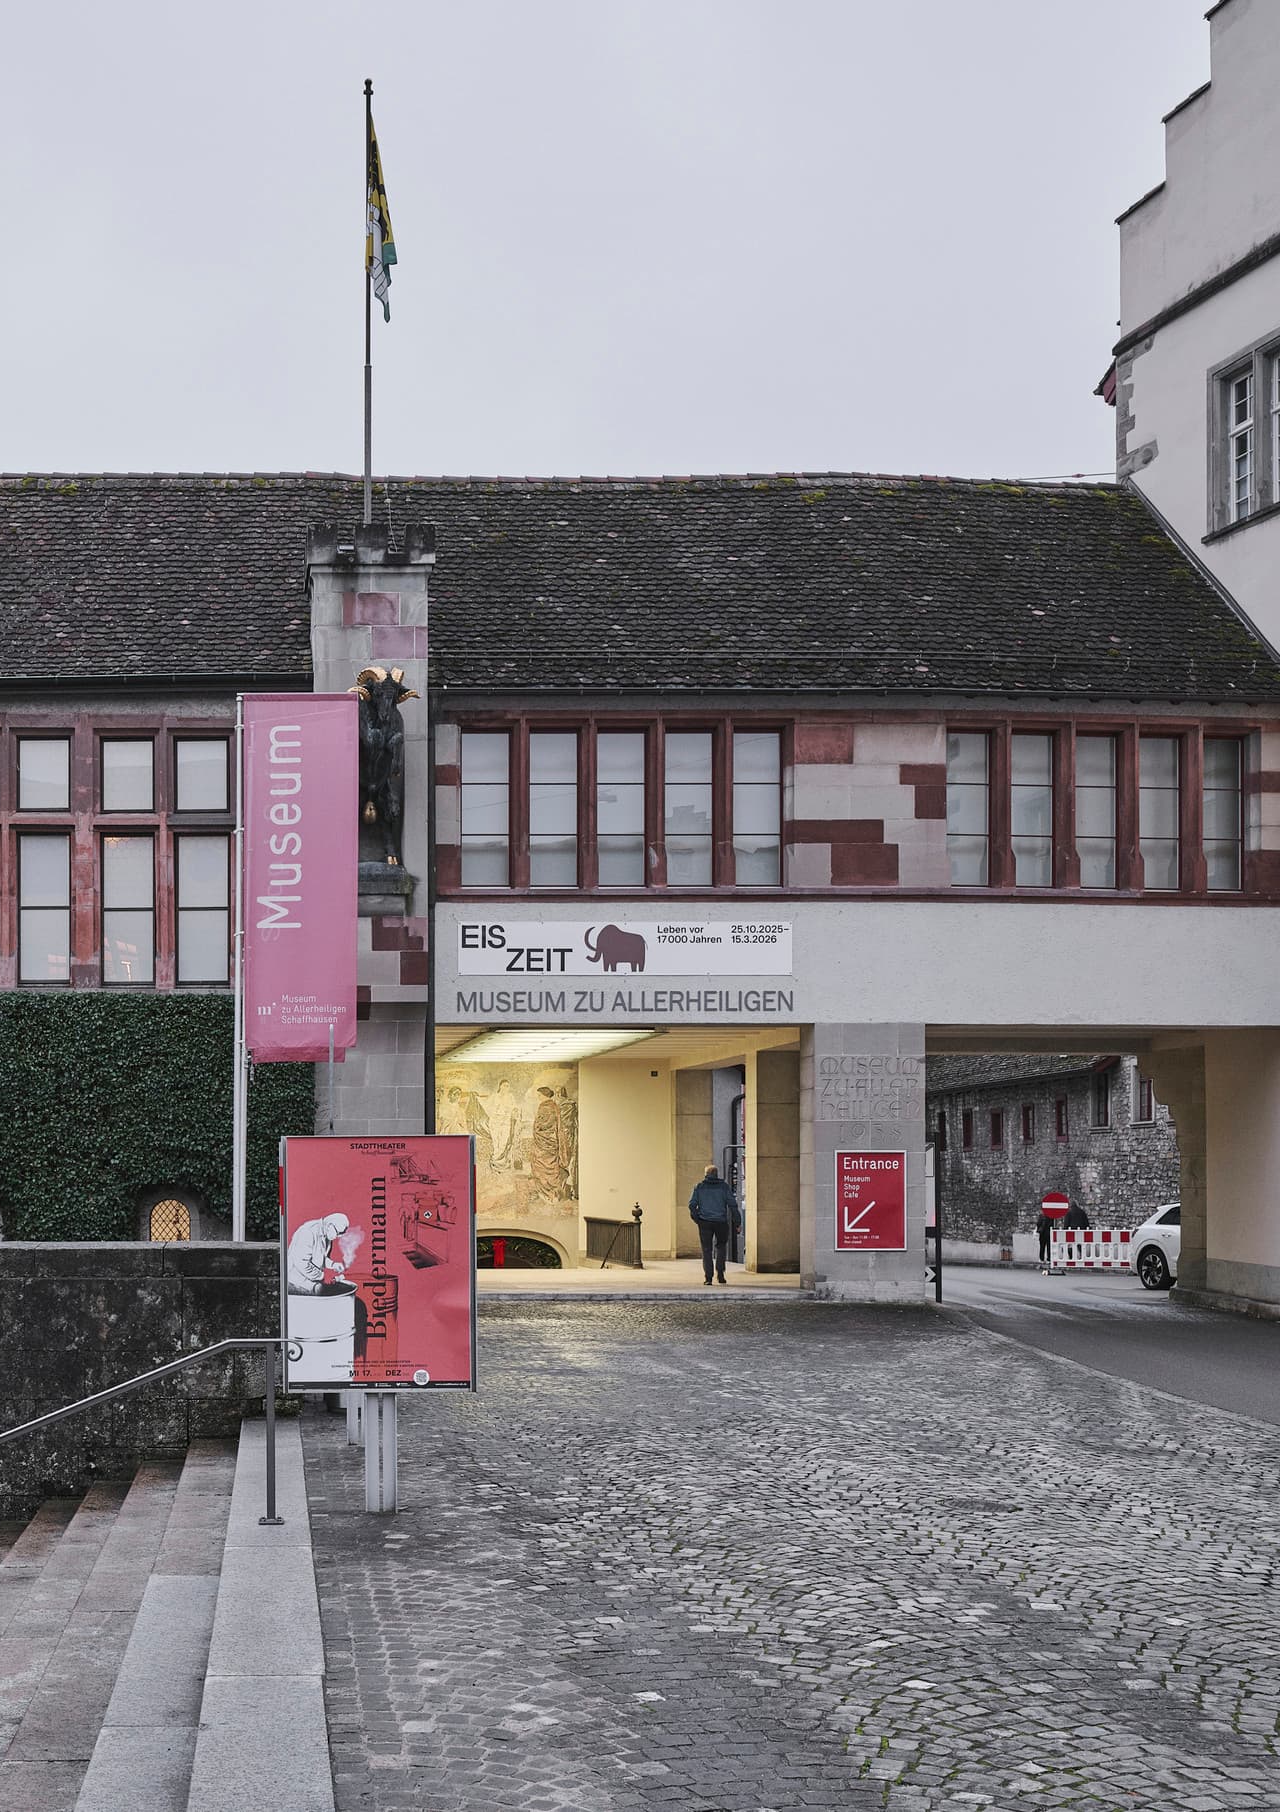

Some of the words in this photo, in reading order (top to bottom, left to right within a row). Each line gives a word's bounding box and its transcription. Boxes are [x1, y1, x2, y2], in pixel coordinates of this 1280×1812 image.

[256, 724, 302, 929] Museum
[657, 925, 687, 934] Leben
[689, 926, 704, 934] vor
[461, 924, 506, 949] EIS
[689, 934, 722, 944] Jahren
[730, 934, 777, 944] 15.3.2026
[506, 948, 573, 972] ZEIT
[281, 994, 317, 1003] Museum
[457, 991, 566, 1013] MUSEUM
[573, 991, 605, 1013] ZU
[611, 990, 794, 1013] ALLERHEILIGEN
[281, 1006, 291, 1014] zu
[293, 1005, 347, 1015] Allerheiligen
[281, 1015, 338, 1024] Schaffhausen
[349, 1142, 406, 1150] STADTTHEATER
[843, 1156, 900, 1170] Entrance
[843, 1175, 871, 1183] Museum
[843, 1183, 861, 1192] Shop
[362, 1175, 388, 1341] Biedermann
[349, 1369, 360, 1377] MI
[385, 1369, 402, 1377] DEZ
